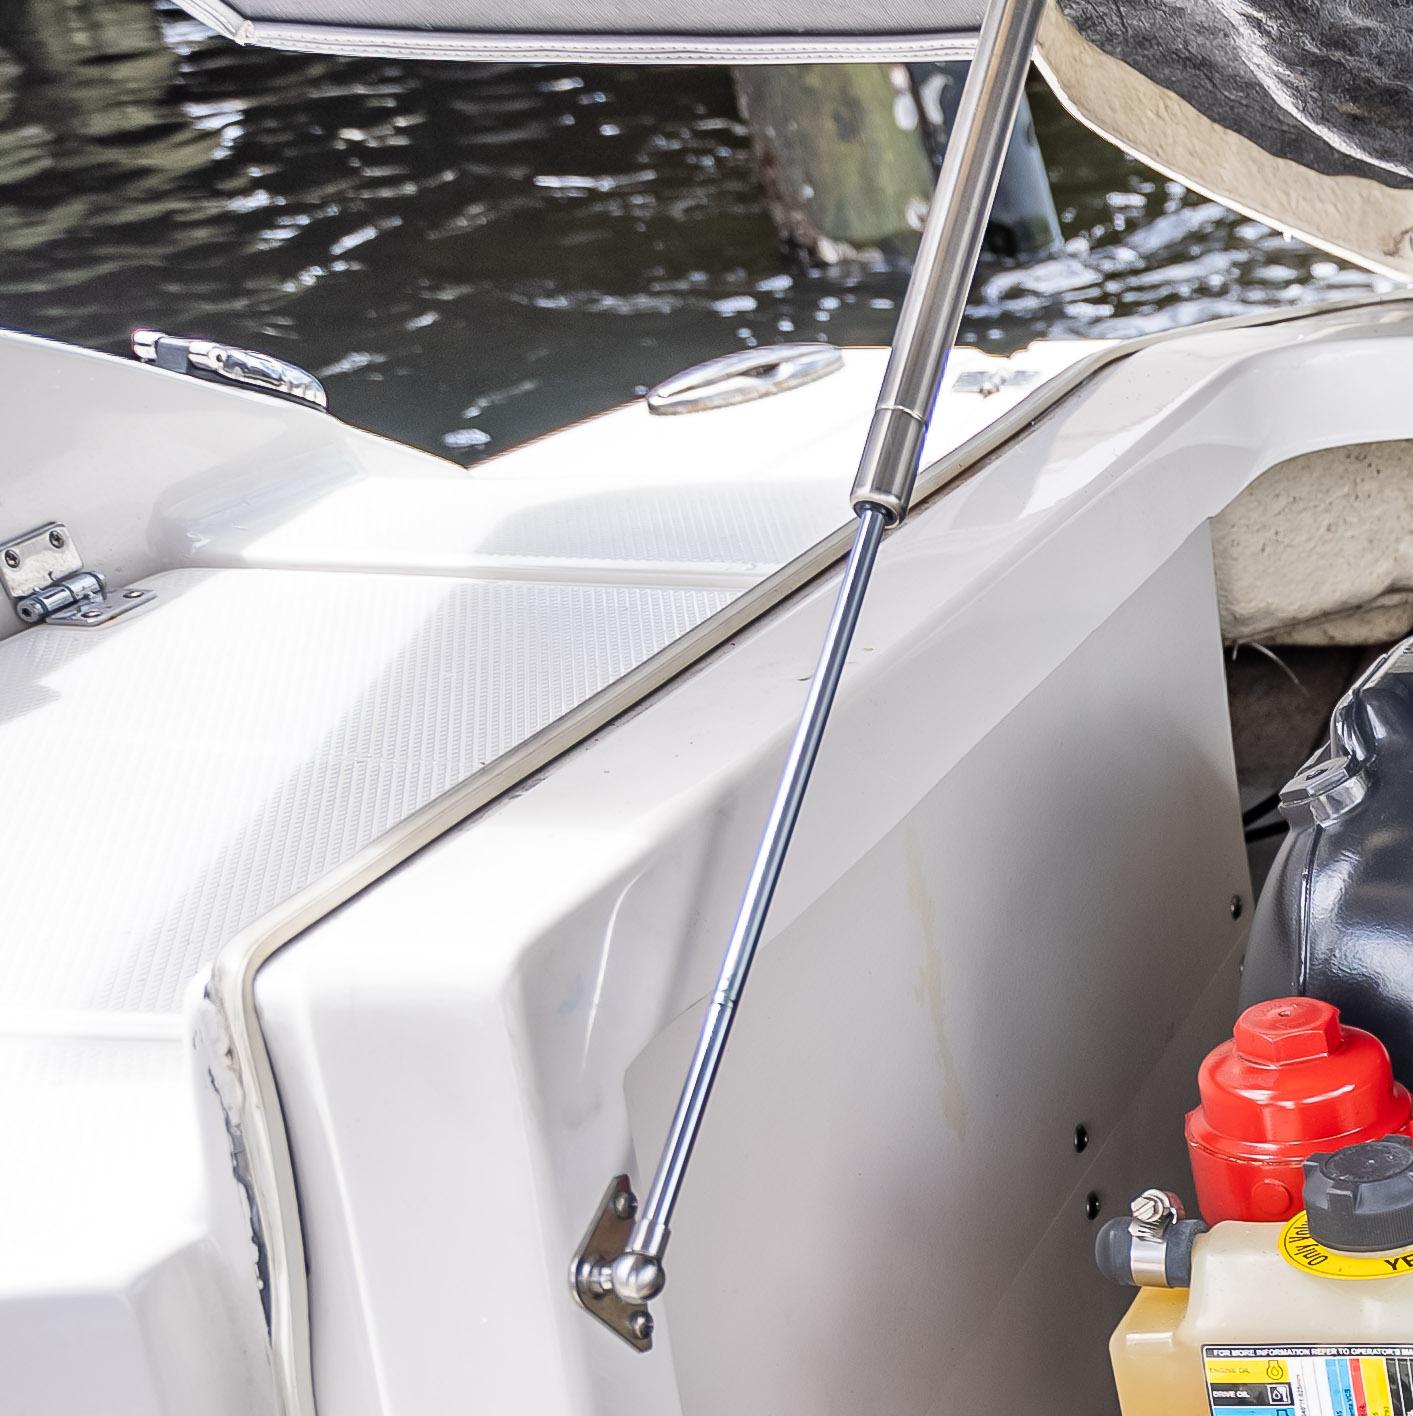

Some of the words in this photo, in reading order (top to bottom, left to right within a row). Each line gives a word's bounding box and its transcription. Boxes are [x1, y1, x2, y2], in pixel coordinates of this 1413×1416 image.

[1294, 1244, 1328, 1266] Only
[1231, 1349, 1255, 1357] MORE
[1256, 1349, 1310, 1357] INFORMATION
[1311, 1348, 1338, 1356] REFER
[1339, 1348, 1350, 1356] TO
